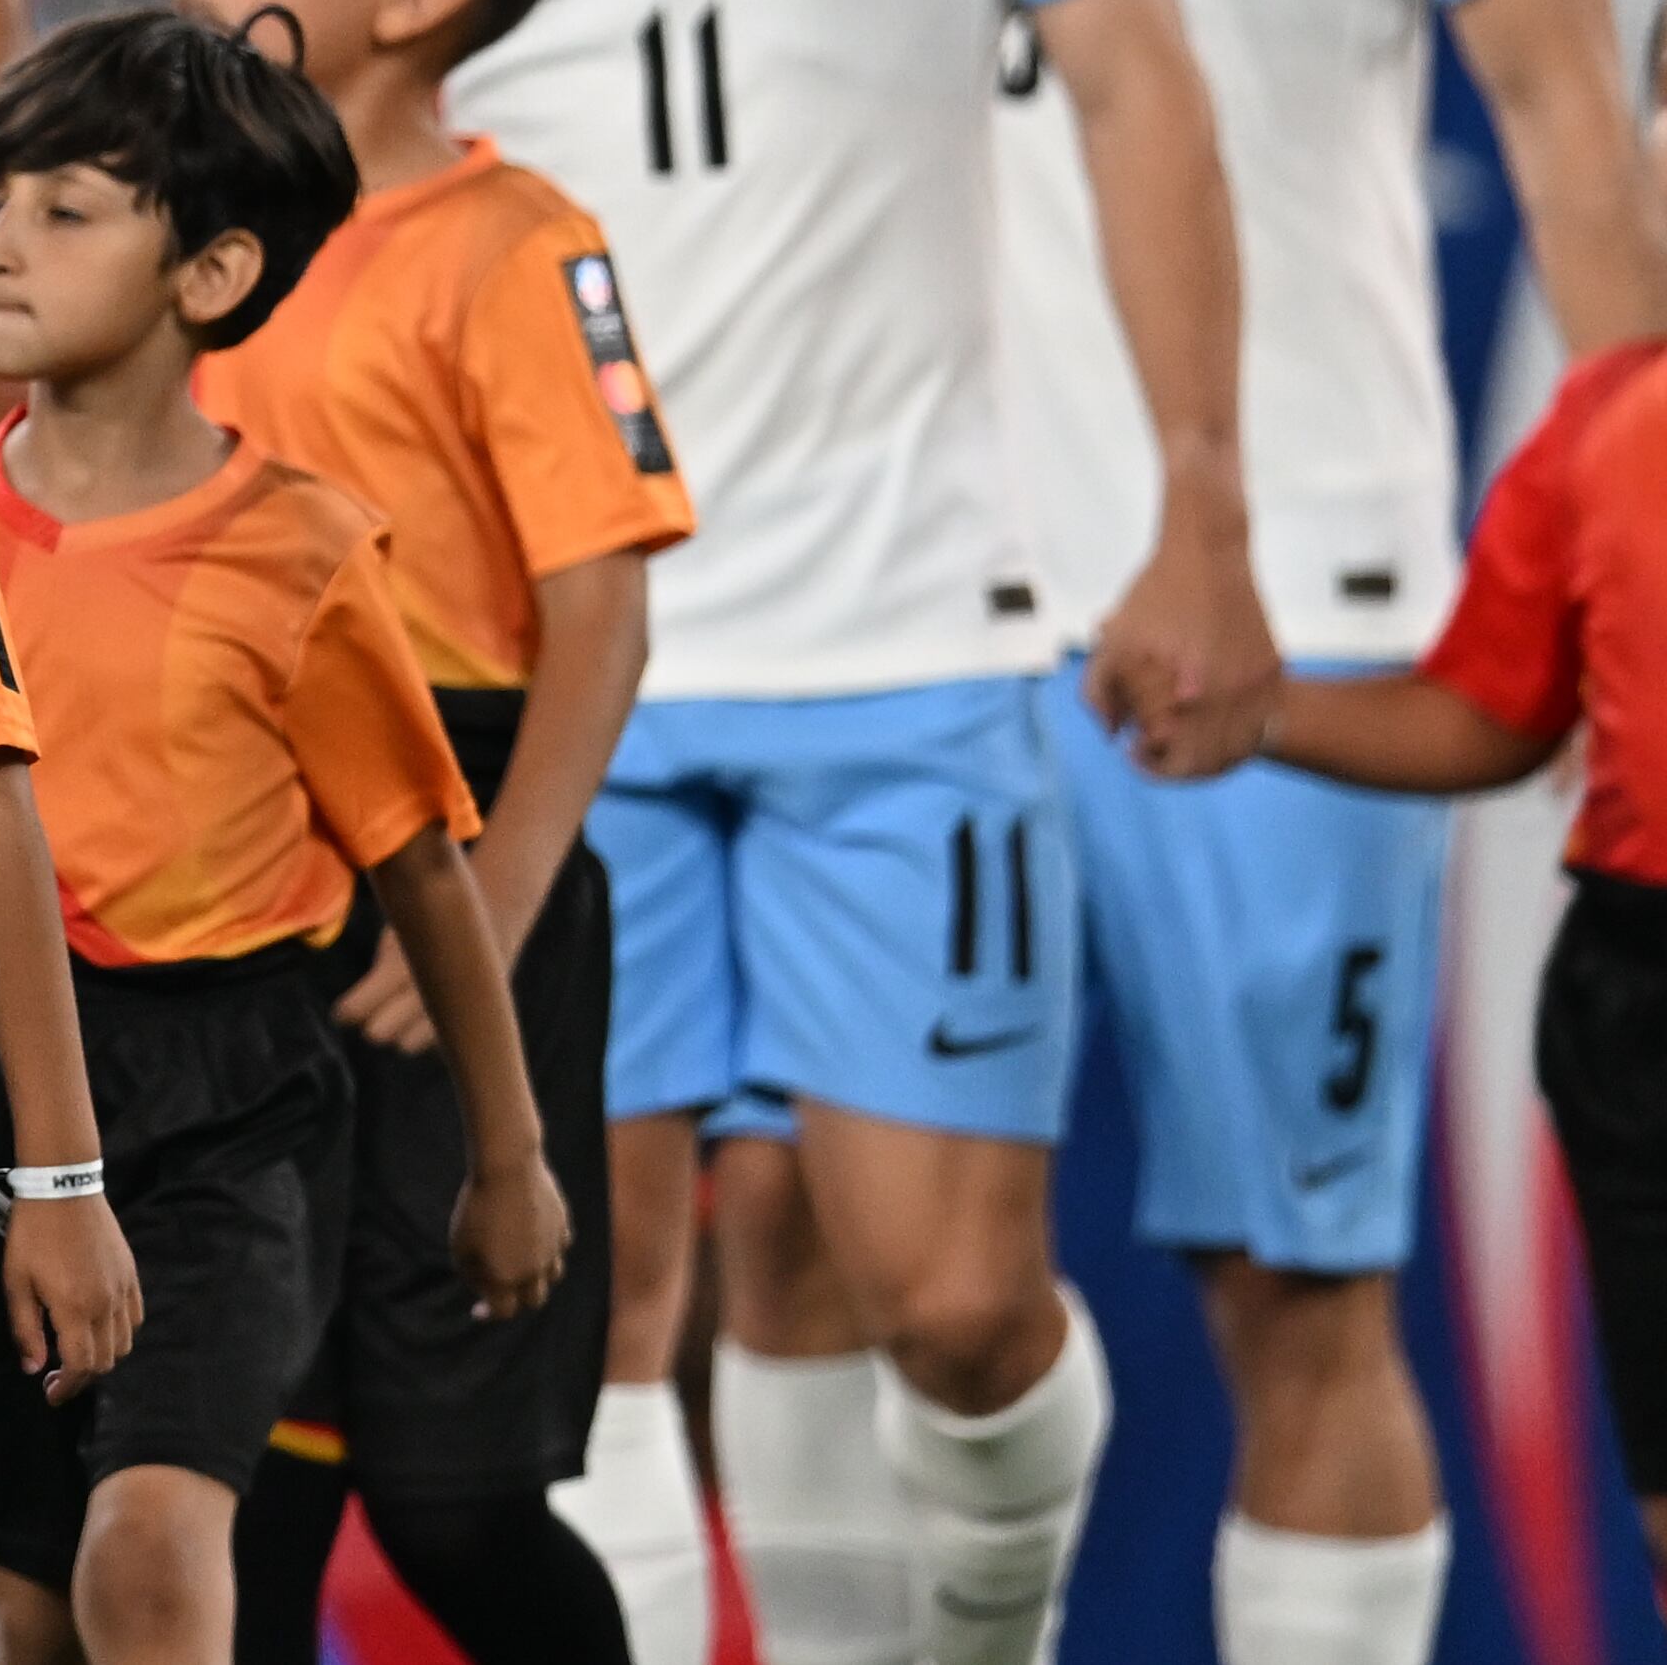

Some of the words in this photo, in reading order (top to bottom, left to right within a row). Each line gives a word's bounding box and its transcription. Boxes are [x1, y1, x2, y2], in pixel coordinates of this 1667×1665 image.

[638, 3, 729, 179] 11
[950, 814, 1033, 984] 11
[1325, 947, 1383, 1115] 5
